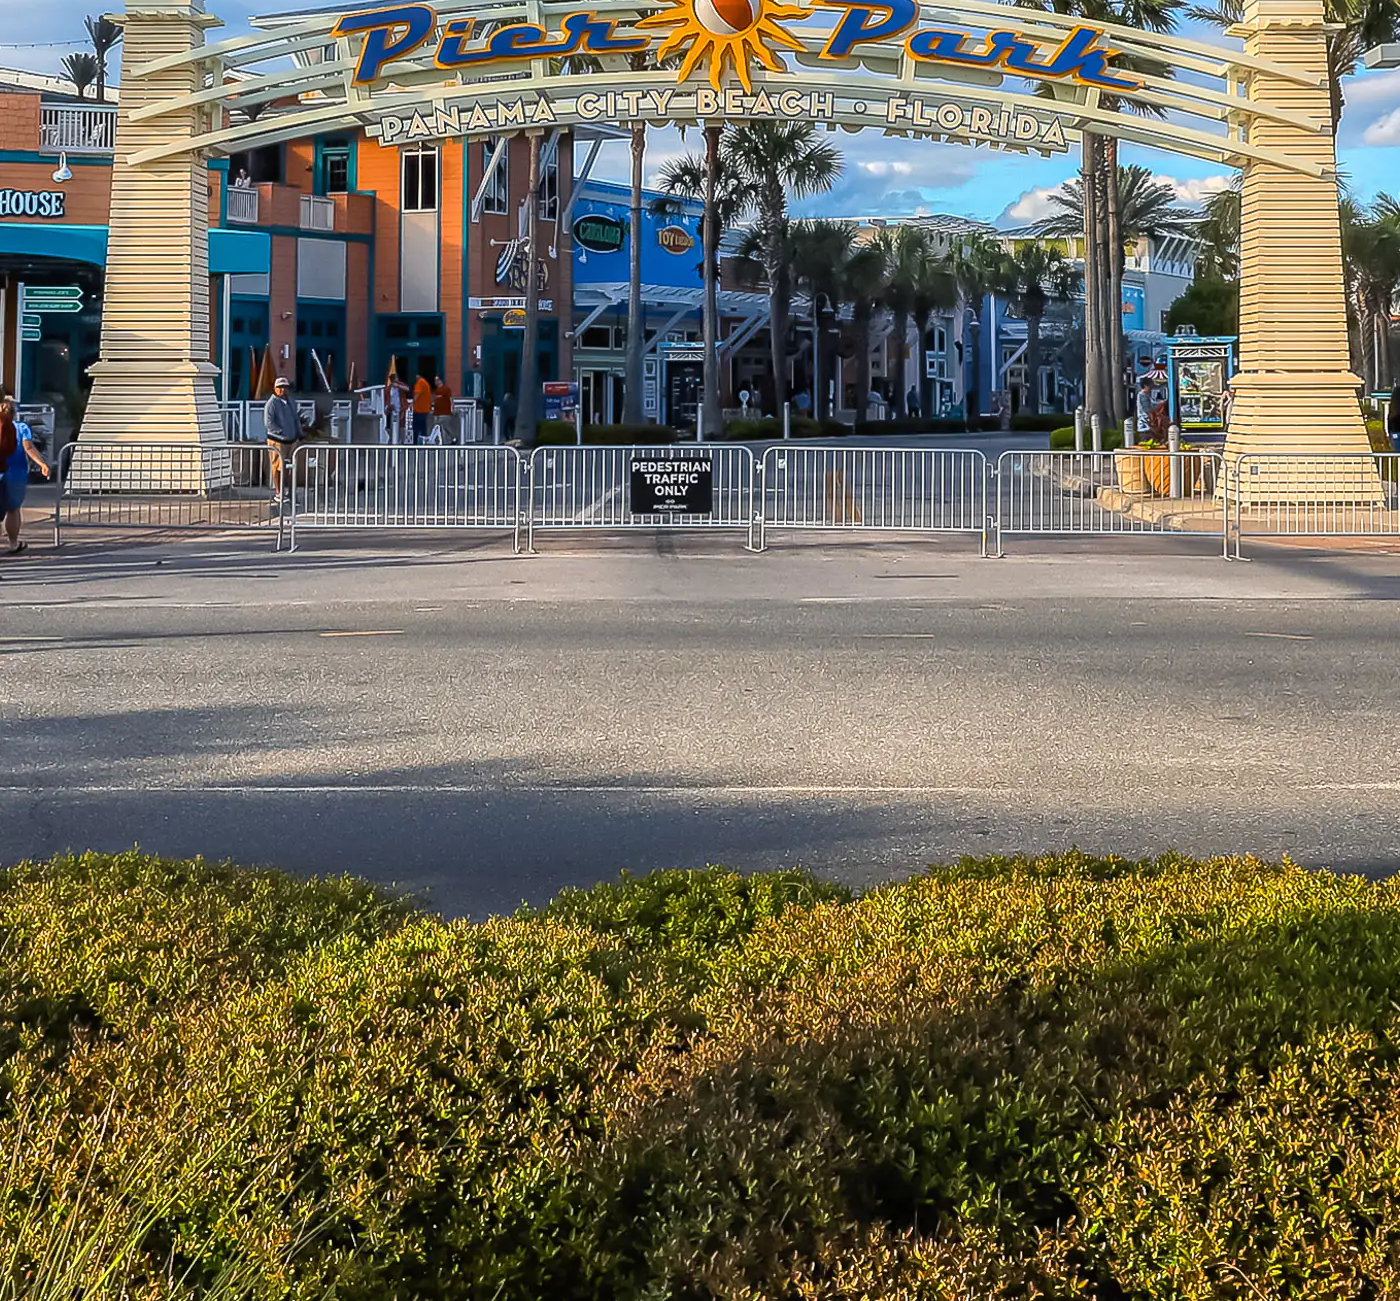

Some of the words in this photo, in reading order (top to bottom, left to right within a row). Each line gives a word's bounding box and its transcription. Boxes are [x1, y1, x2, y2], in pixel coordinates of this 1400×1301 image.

[331, 3, 652, 87] Pier
[379, 95, 557, 144] PANAMA
[576, 89, 675, 119] CITY
[695, 87, 834, 119] BEACH
[886, 98, 1067, 148] FLORIDA
[0, 189, 64, 216] HOUSE
[658, 231, 674, 246] TOY
[632, 461, 711, 472] PEDESTRIAN
[644, 473, 699, 484] TRAFFIC
[654, 485, 689, 496] ONLY
